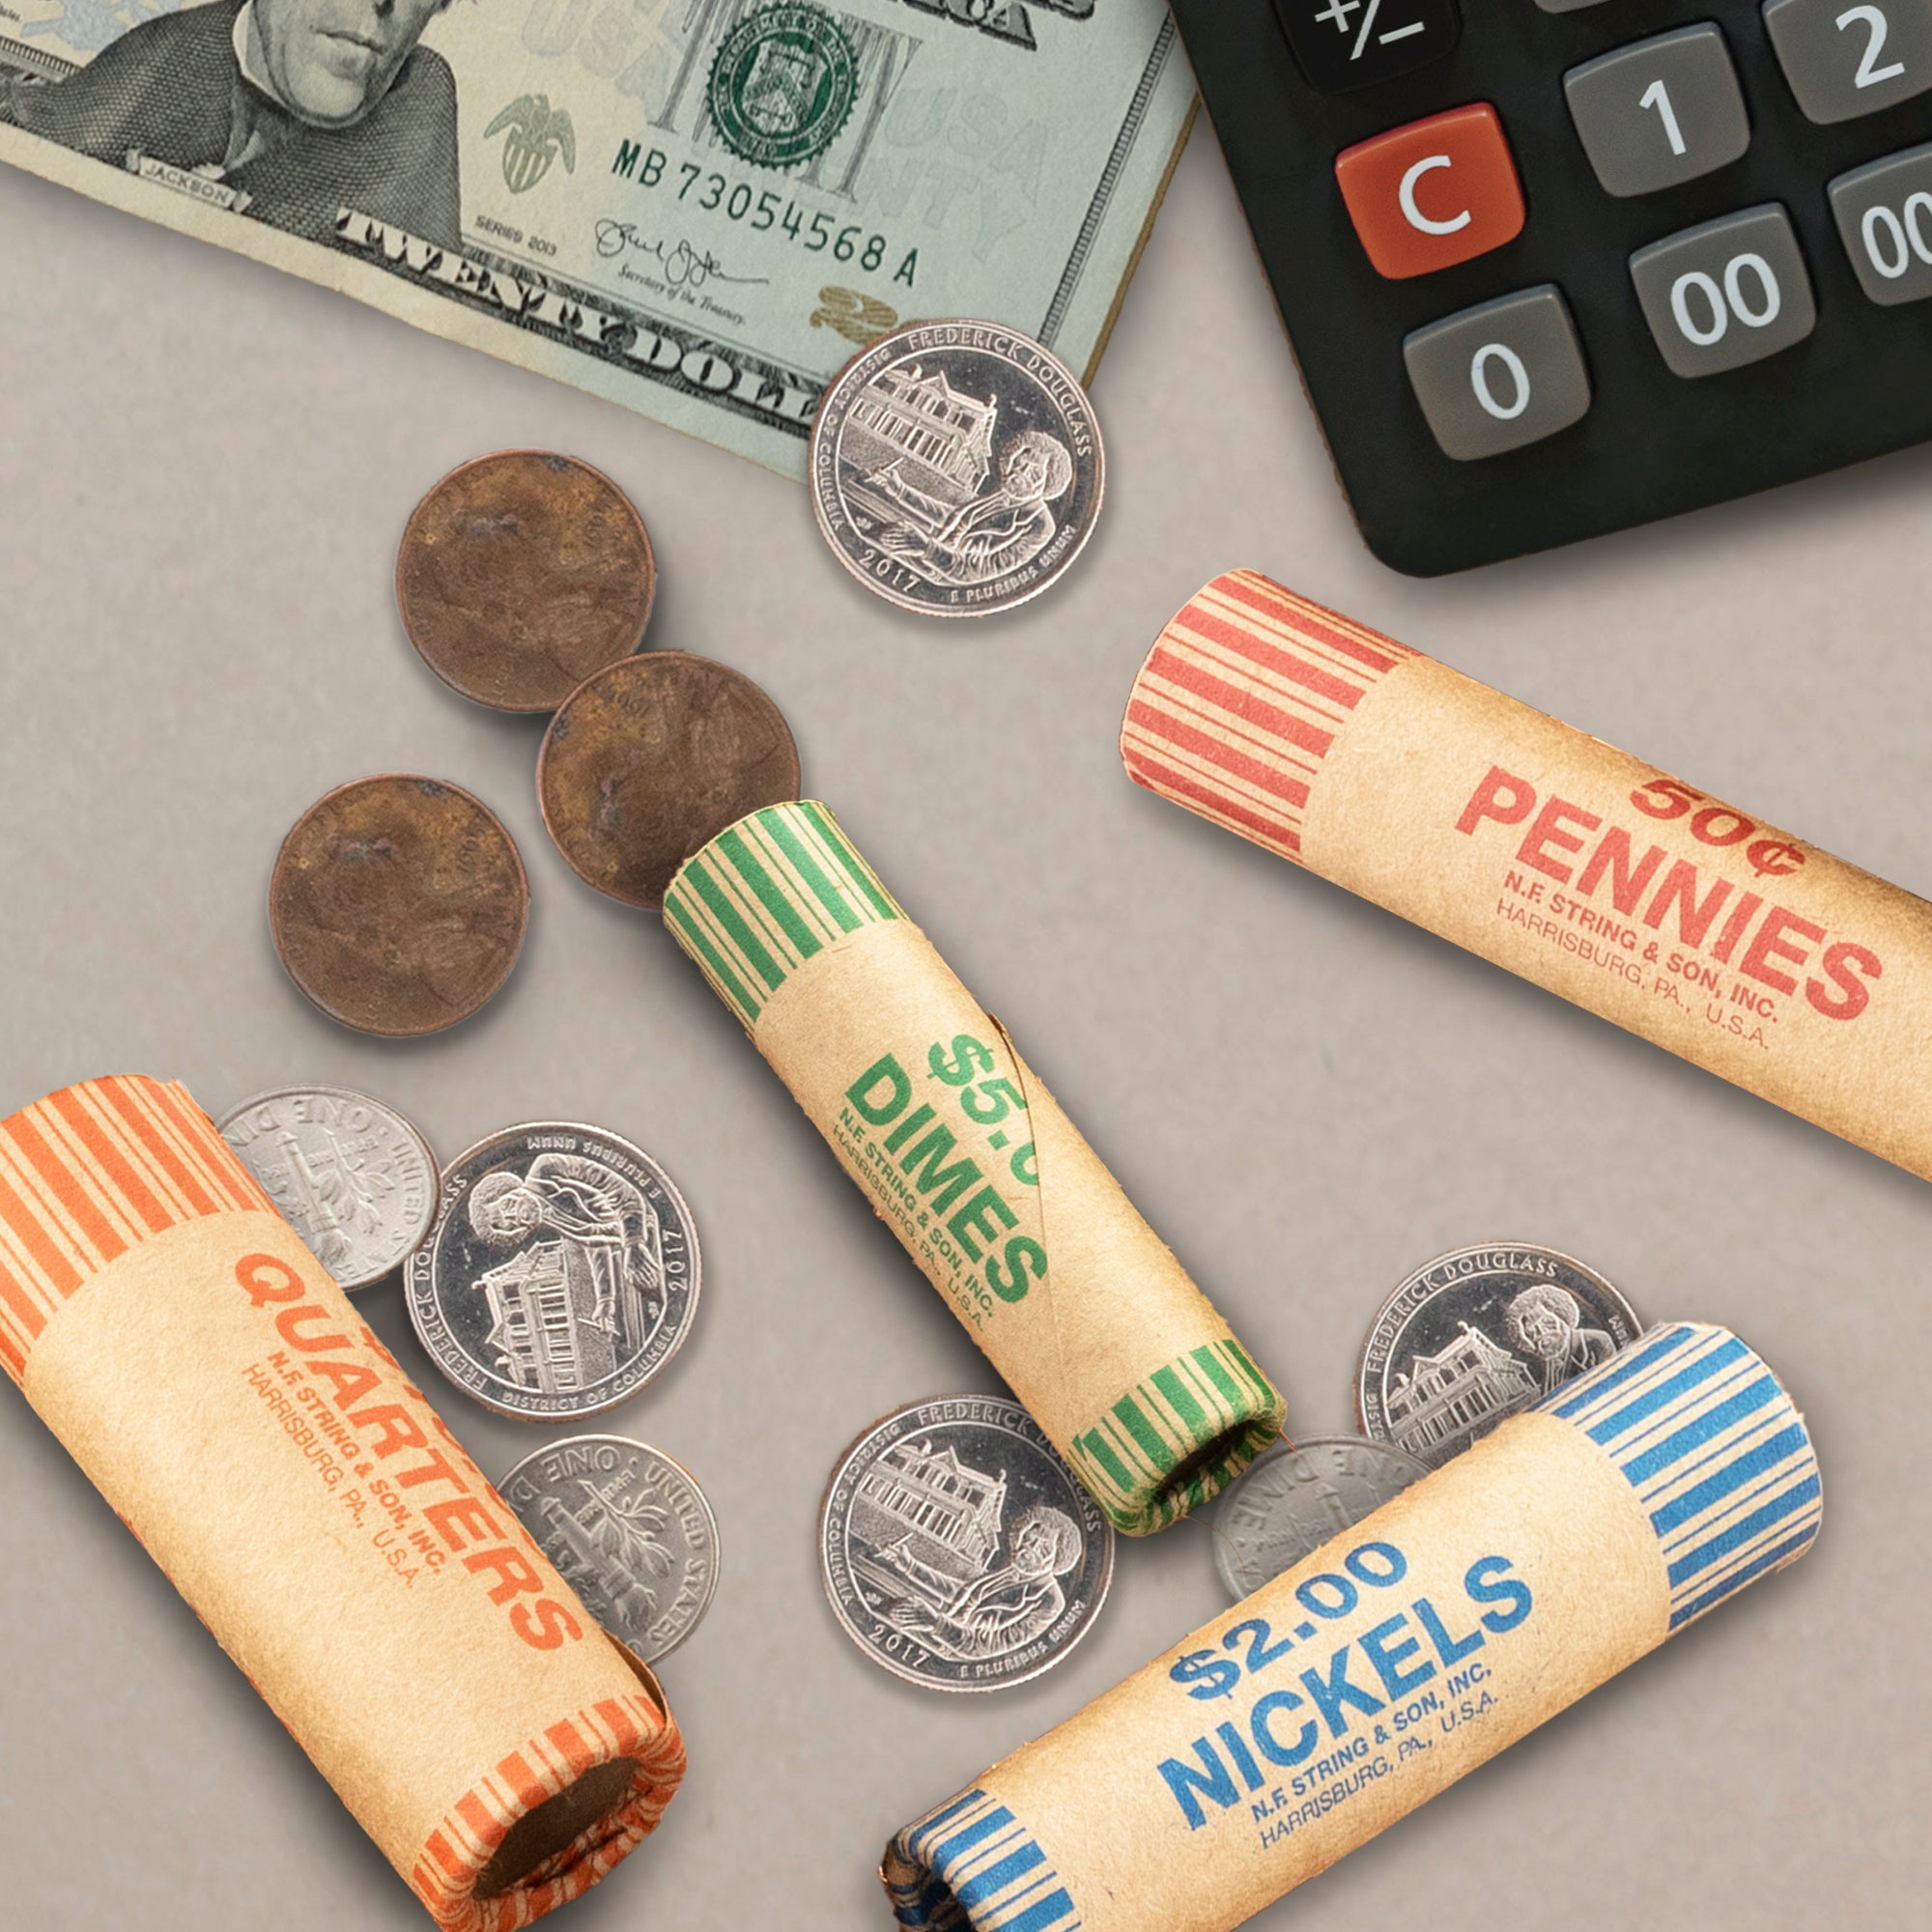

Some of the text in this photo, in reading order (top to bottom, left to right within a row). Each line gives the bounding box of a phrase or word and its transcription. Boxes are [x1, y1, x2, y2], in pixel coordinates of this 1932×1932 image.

[1835, 5, 1905, 90] 2
[1639, 79, 1687, 155] 1
[148, 161, 231, 206] JACKSON
[611, 138, 667, 187] MB
[678, 162, 887, 271] 73054568
[894, 248, 918, 287] A
[1398, 155, 1472, 235] C
[475, 214, 557, 257] SERIES 2013
[336, 206, 630, 348] TWENTY
[626, 326, 831, 428] DOLL
[1670, 253, 1781, 345] 00
[908, 327, 1093, 457] FREDERICK DOUGLASS
[1470, 343, 1531, 420] 0
[818, 442, 848, 531] COLUMBIA
[858, 550, 921, 593] 2017
[966, 565, 1039, 602] PLURIBUS
[1038, 525, 1077, 568] UNUM
[1630, 780, 1805, 877] 50¢
[1455, 764, 1883, 1021] PENNIES
[1503, 870, 1778, 1024] N.F. STRING & SON, INC.
[582, 1141, 646, 1185] PLURIBUS
[844, 1052, 1048, 1303] DIMES
[839, 1107, 994, 1318] N.F. STRING & SON, INC.
[662, 1228, 689, 1292] 2017
[415, 1288, 488, 1392] FREDERICK
[1367, 1252, 1559, 1374] FREDERICK DOUGLASS
[501, 1324, 678, 1411] DISTRICT OF COLUMBIA
[235, 1253, 583, 1652] QUARTERS
[918, 1403, 1034, 1434] FREDERICK
[268, 1351, 451, 1576] N.F. STRING & SON, INC.
[541, 1445, 621, 1482] ONE
[645, 1461, 708, 1550] UNITED
[828, 1518, 858, 1606] COLUMBIA
[867, 1625, 930, 1668] 2017
[976, 1640, 1049, 1677] PLURIBUS
[1048, 1600, 1087, 1643] UNUM
[1169, 1541, 1408, 1700] $2.00
[1156, 1555, 1533, 1832] NICKELS
[1251, 1662, 1493, 1823] N.F. STRING & SON, INC.
